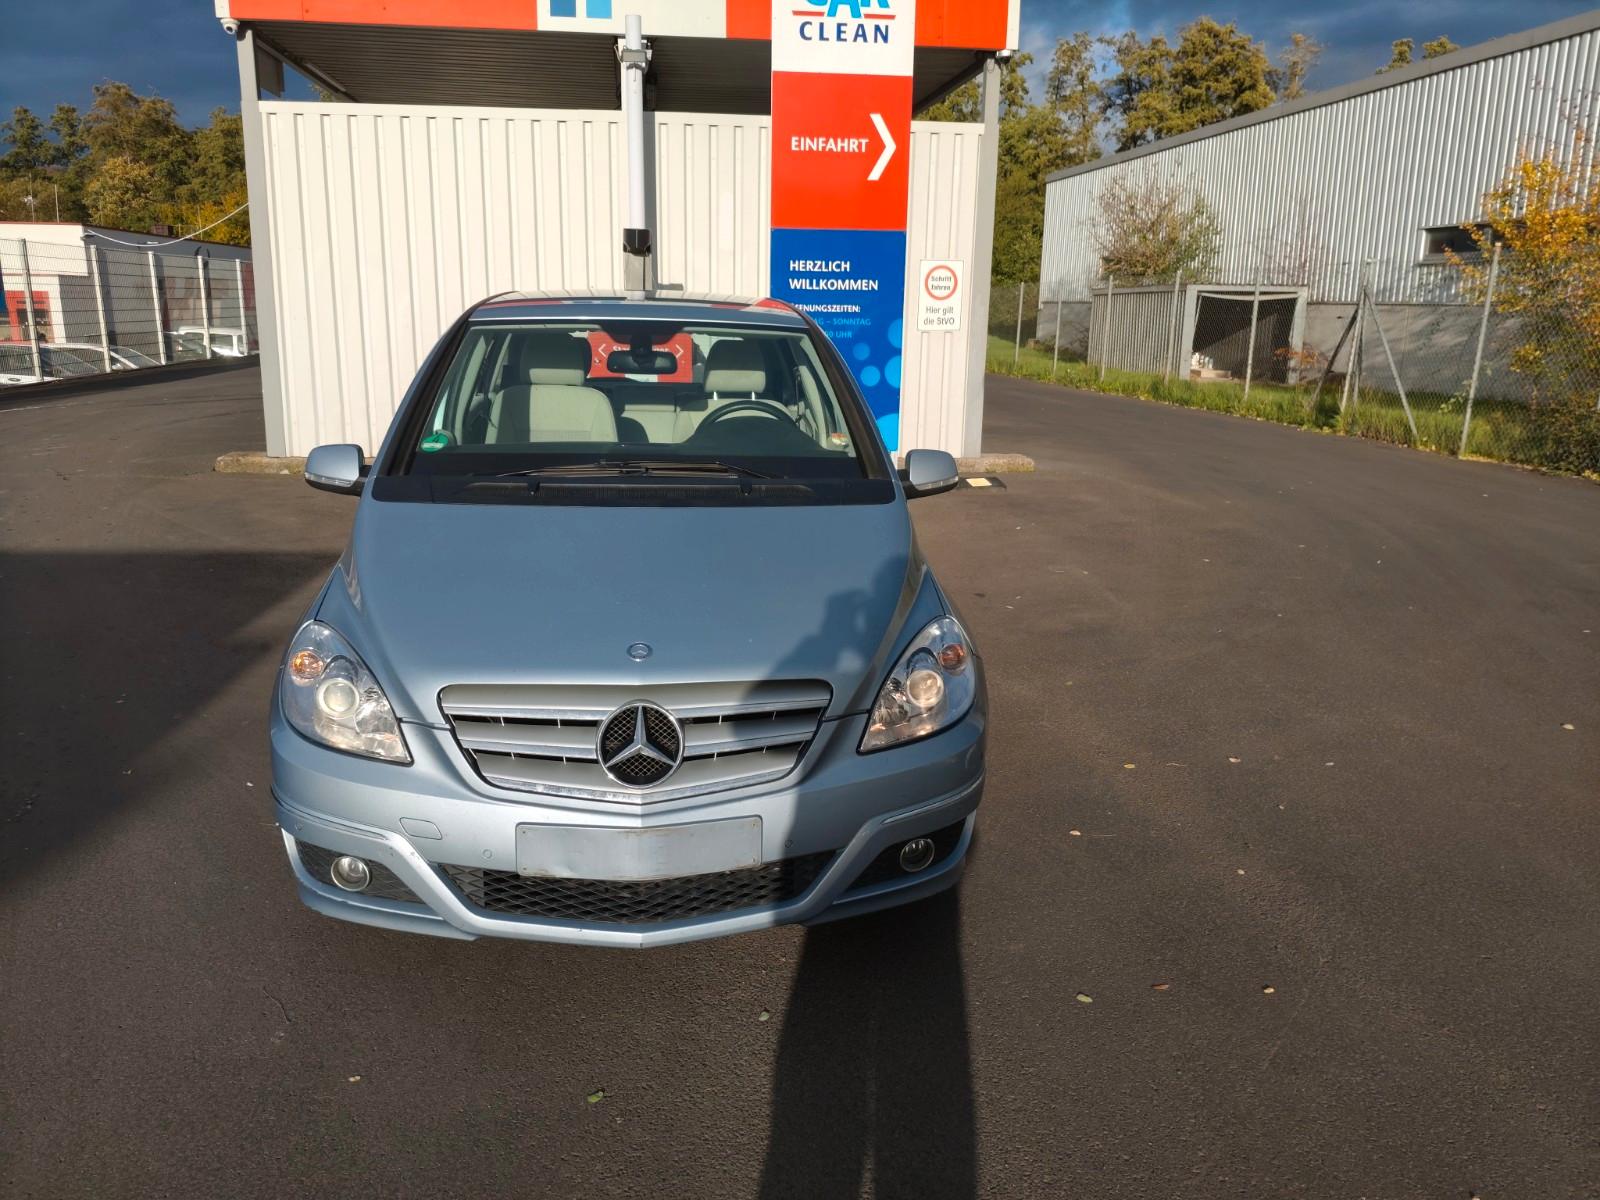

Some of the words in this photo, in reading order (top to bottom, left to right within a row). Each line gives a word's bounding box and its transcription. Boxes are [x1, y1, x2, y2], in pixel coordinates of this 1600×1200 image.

[799, 21, 889, 43] CLEAN
[791, 136, 869, 152] EINFAHRT
[789, 260, 850, 272] HERZLICH
[789, 278, 879, 291] WILLKOMMEN
[926, 306, 941, 314] Hier
[943, 306, 954, 316] gilt
[833, 318, 871, 326] SONNTAG
[923, 317, 935, 325] die
[936, 317, 955, 326] StVO
[836, 331, 852, 339] UHR
